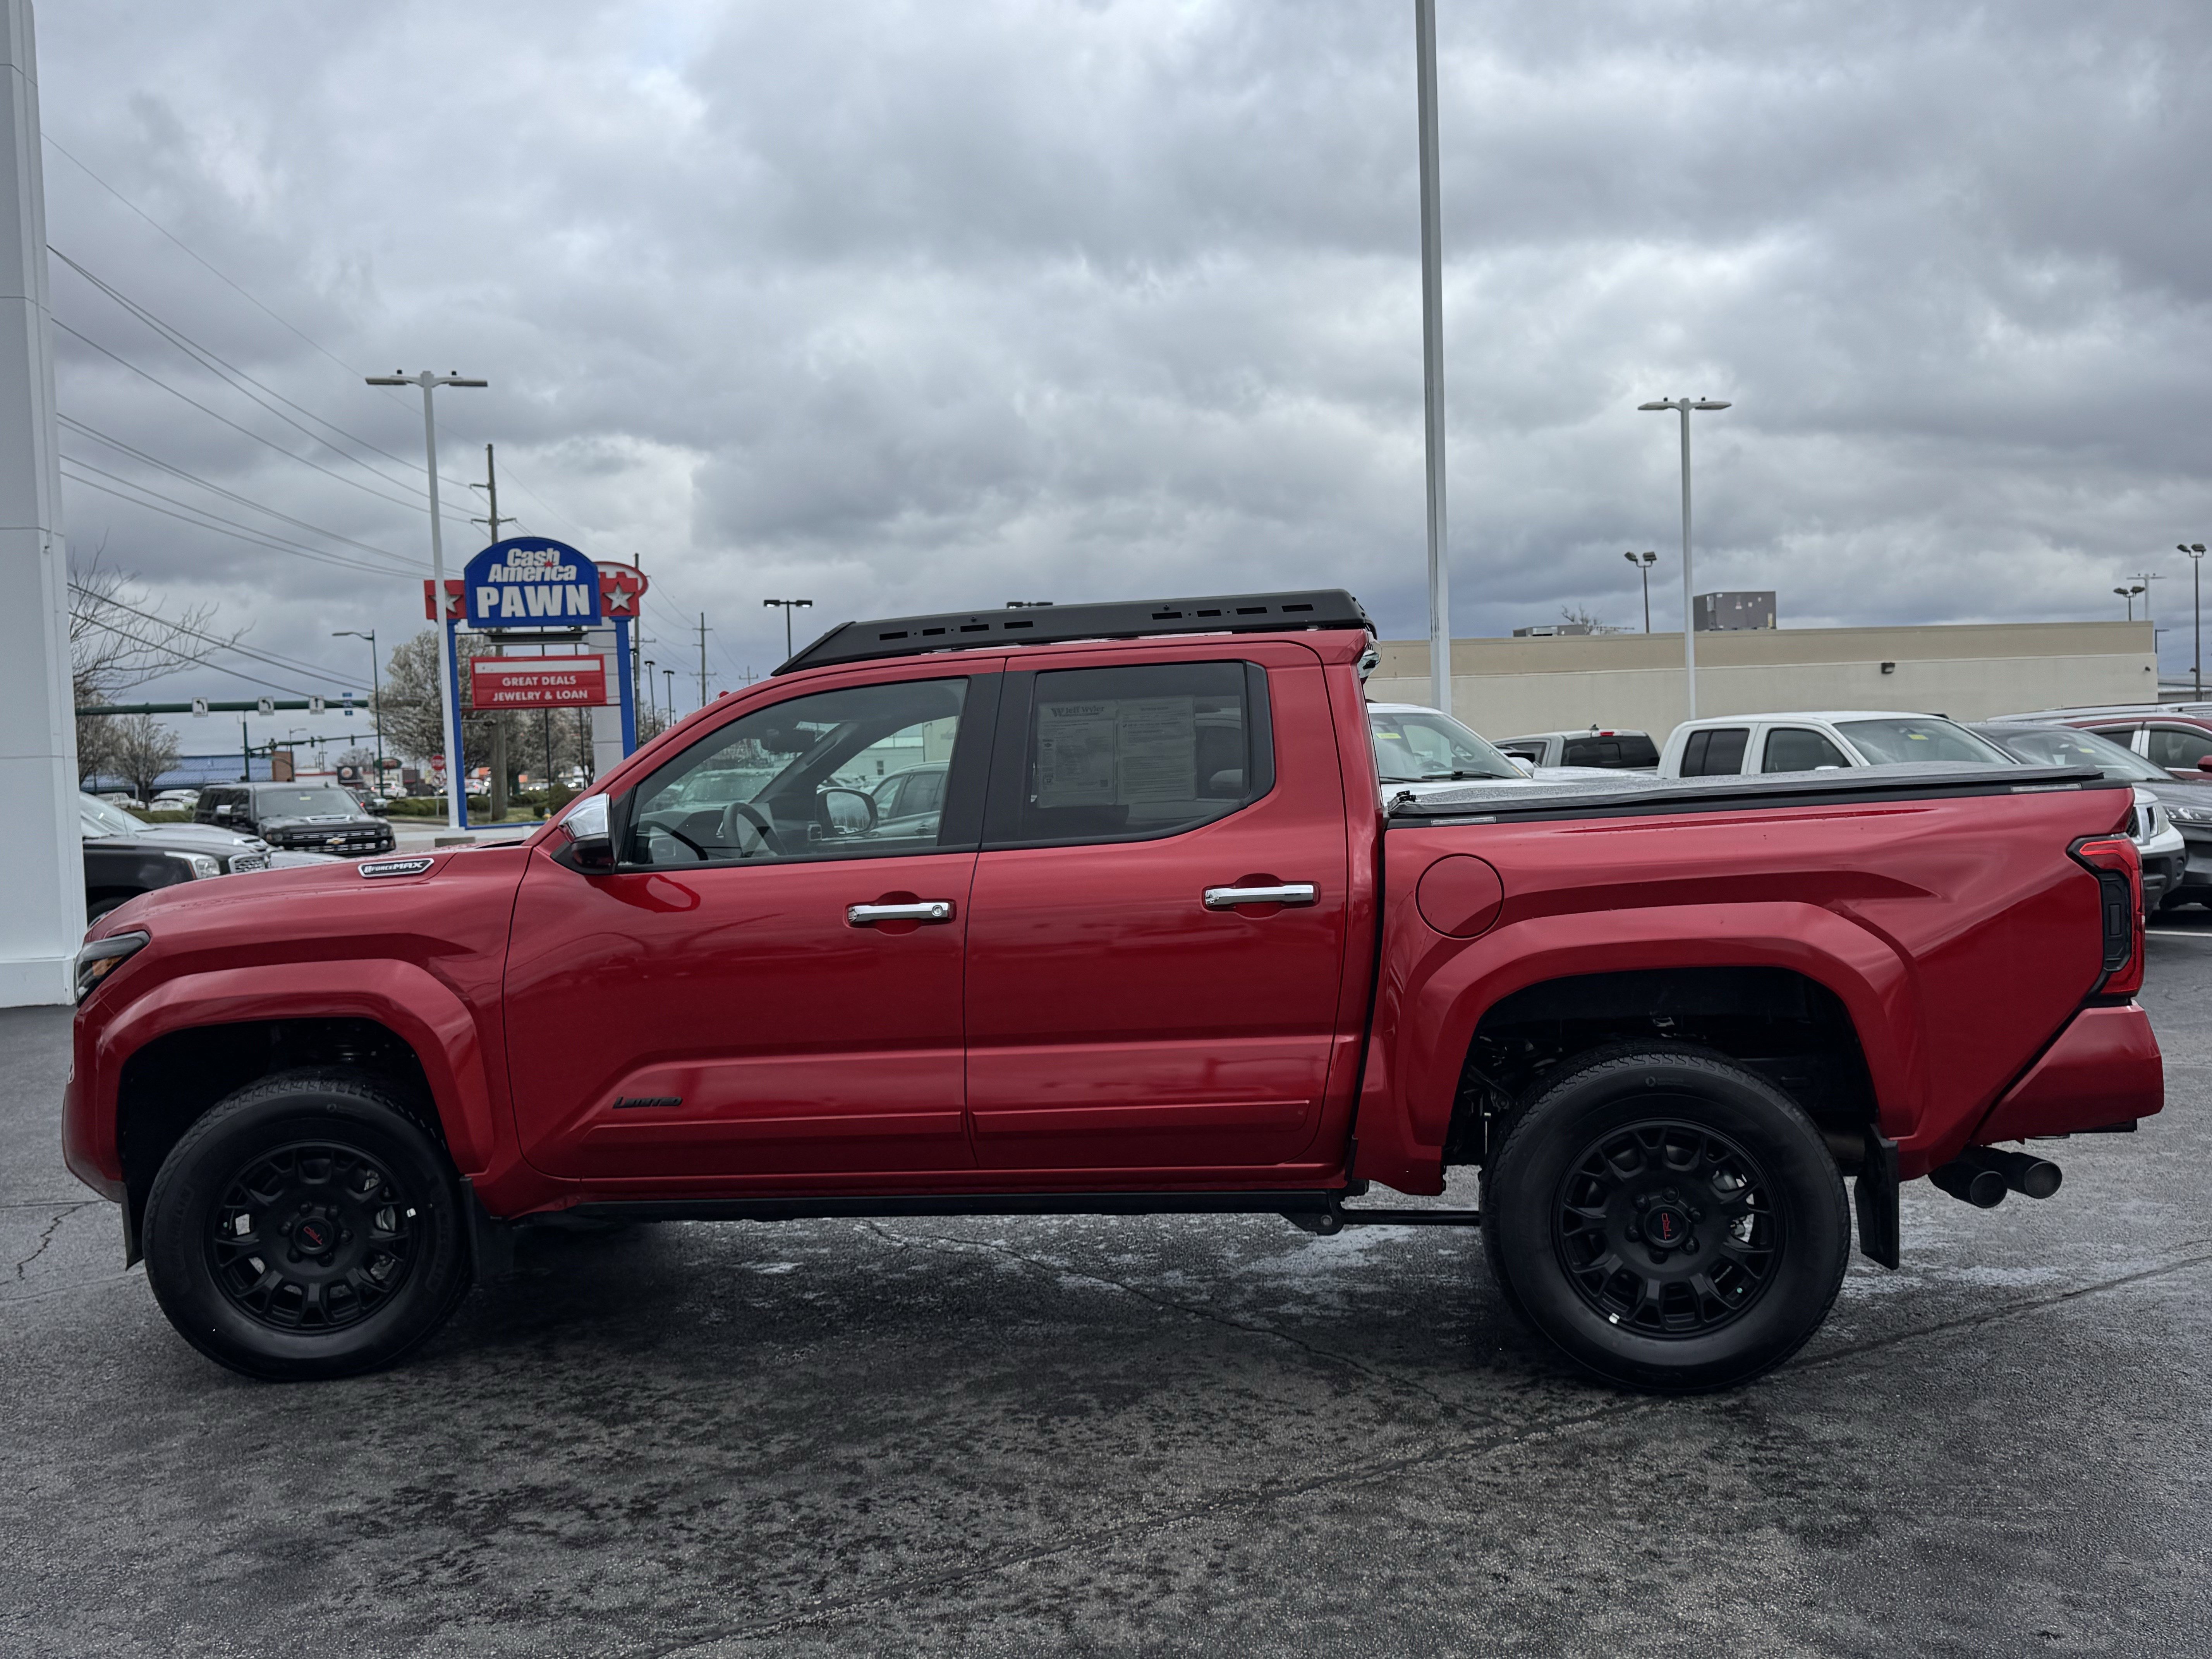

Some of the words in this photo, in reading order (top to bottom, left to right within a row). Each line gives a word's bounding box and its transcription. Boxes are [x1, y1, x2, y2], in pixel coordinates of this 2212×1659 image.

[507, 548, 560, 567] Cash
[488, 563, 577, 582] America
[476, 584, 590, 618] PAWN
[502, 677, 538, 686] GREAT
[542, 675, 576, 685] DEALS
[493, 691, 541, 701] JEWELRY
[544, 690, 552, 700] &
[556, 690, 588, 699] LOAN
[1662, 1213, 1672, 1240] TRD
